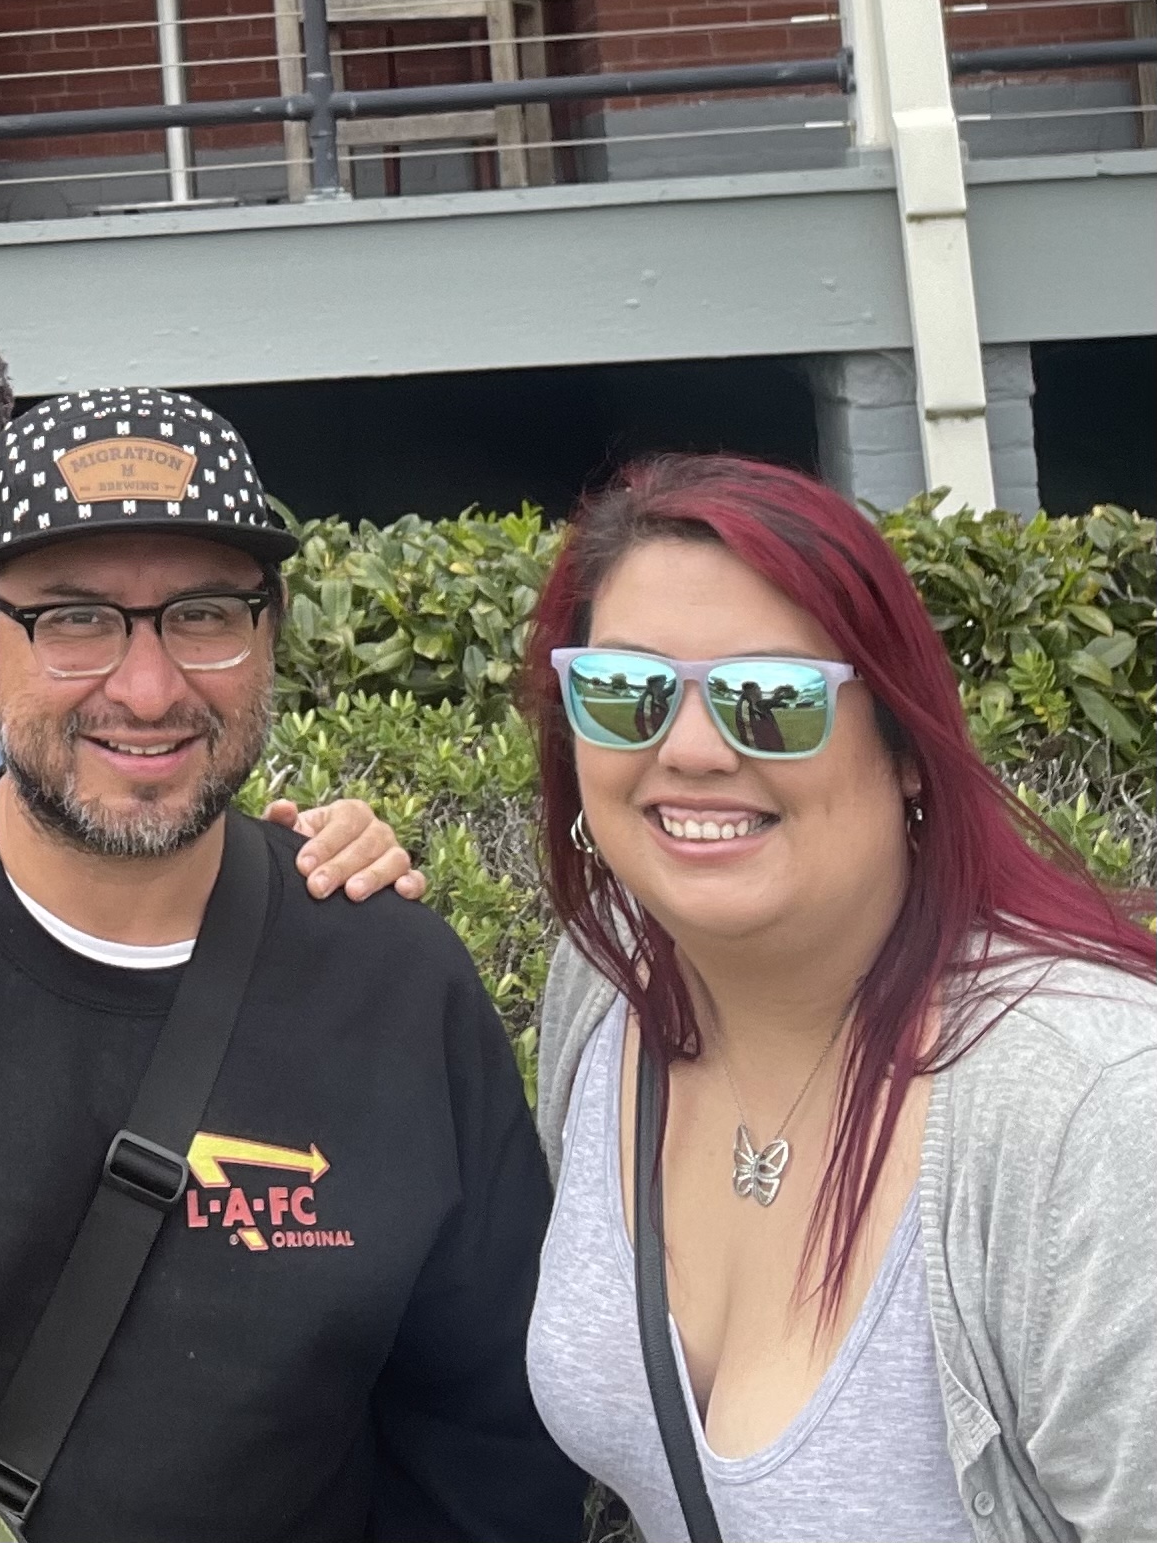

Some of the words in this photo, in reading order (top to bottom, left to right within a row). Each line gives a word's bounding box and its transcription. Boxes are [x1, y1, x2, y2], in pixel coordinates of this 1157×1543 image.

[70, 446, 184, 473] MIGRATION
[99, 481, 160, 492] BREWING
[271, 1230, 355, 1248] ORIGINAL
